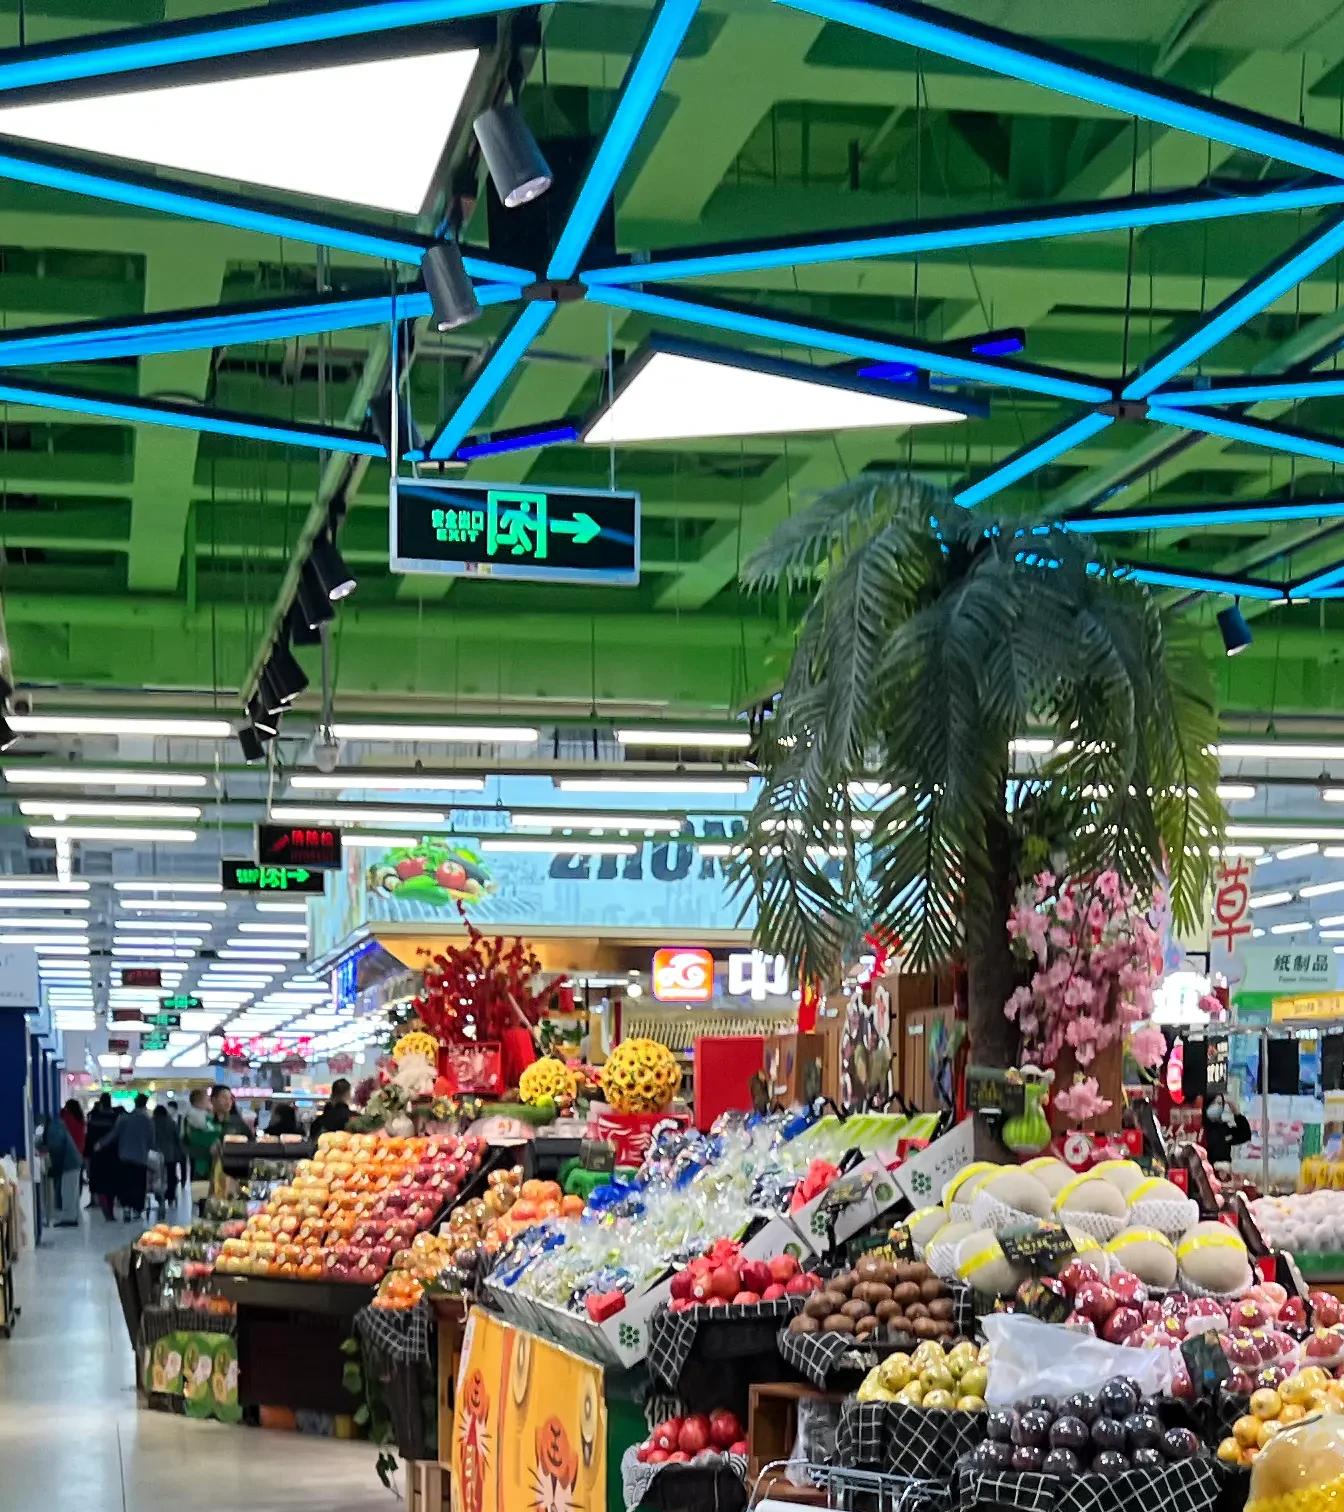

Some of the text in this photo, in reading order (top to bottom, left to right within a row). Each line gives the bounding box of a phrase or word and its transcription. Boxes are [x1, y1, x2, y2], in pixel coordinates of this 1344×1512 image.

[437, 528, 479, 543] EXIT
[1273, 953, 1329, 973] 纸制品
